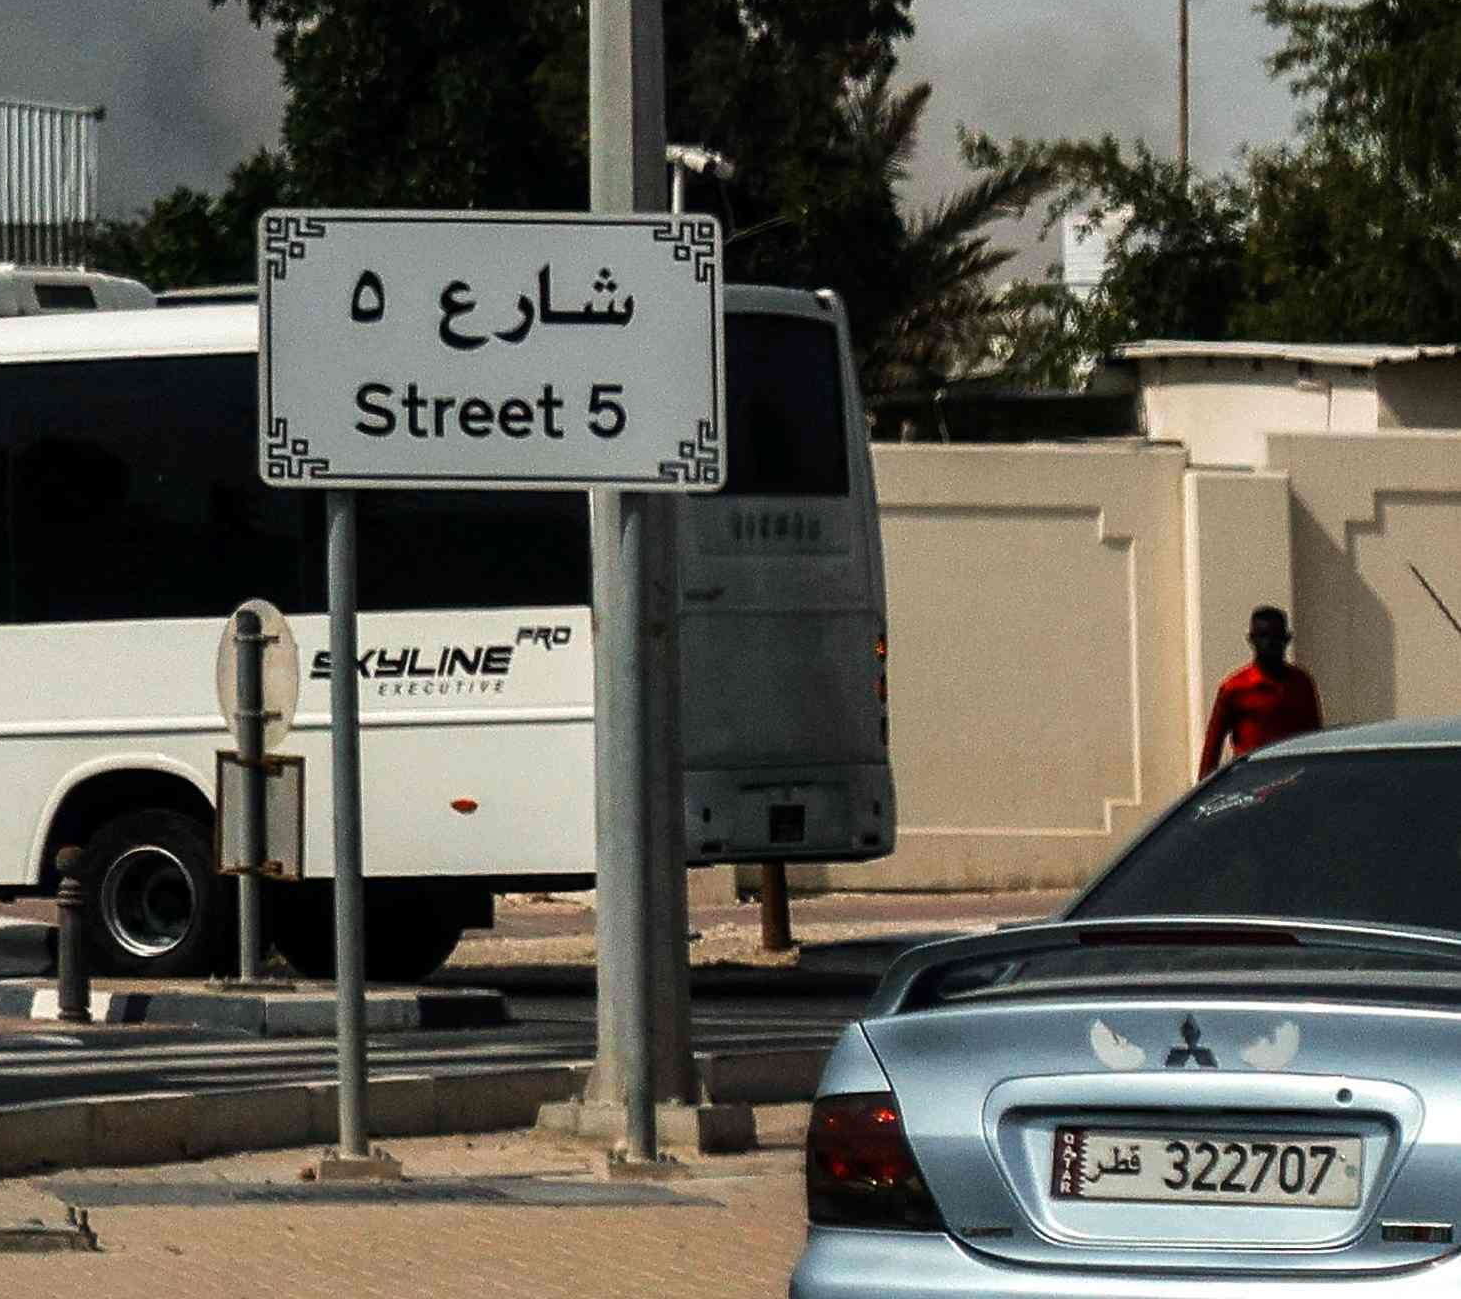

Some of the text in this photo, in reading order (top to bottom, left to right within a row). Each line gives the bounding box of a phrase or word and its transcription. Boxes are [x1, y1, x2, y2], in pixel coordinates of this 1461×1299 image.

[438, 264, 636, 351] شارع
[354, 382, 628, 439] Street 5
[309, 626, 572, 680] SKYLINE PRO
[377, 680, 505, 697] EXECUTIVE
[1059, 1133, 1076, 1193] QATAR
[1084, 1145, 1142, 1184] قطر
[1163, 1141, 1338, 1196] 322707
